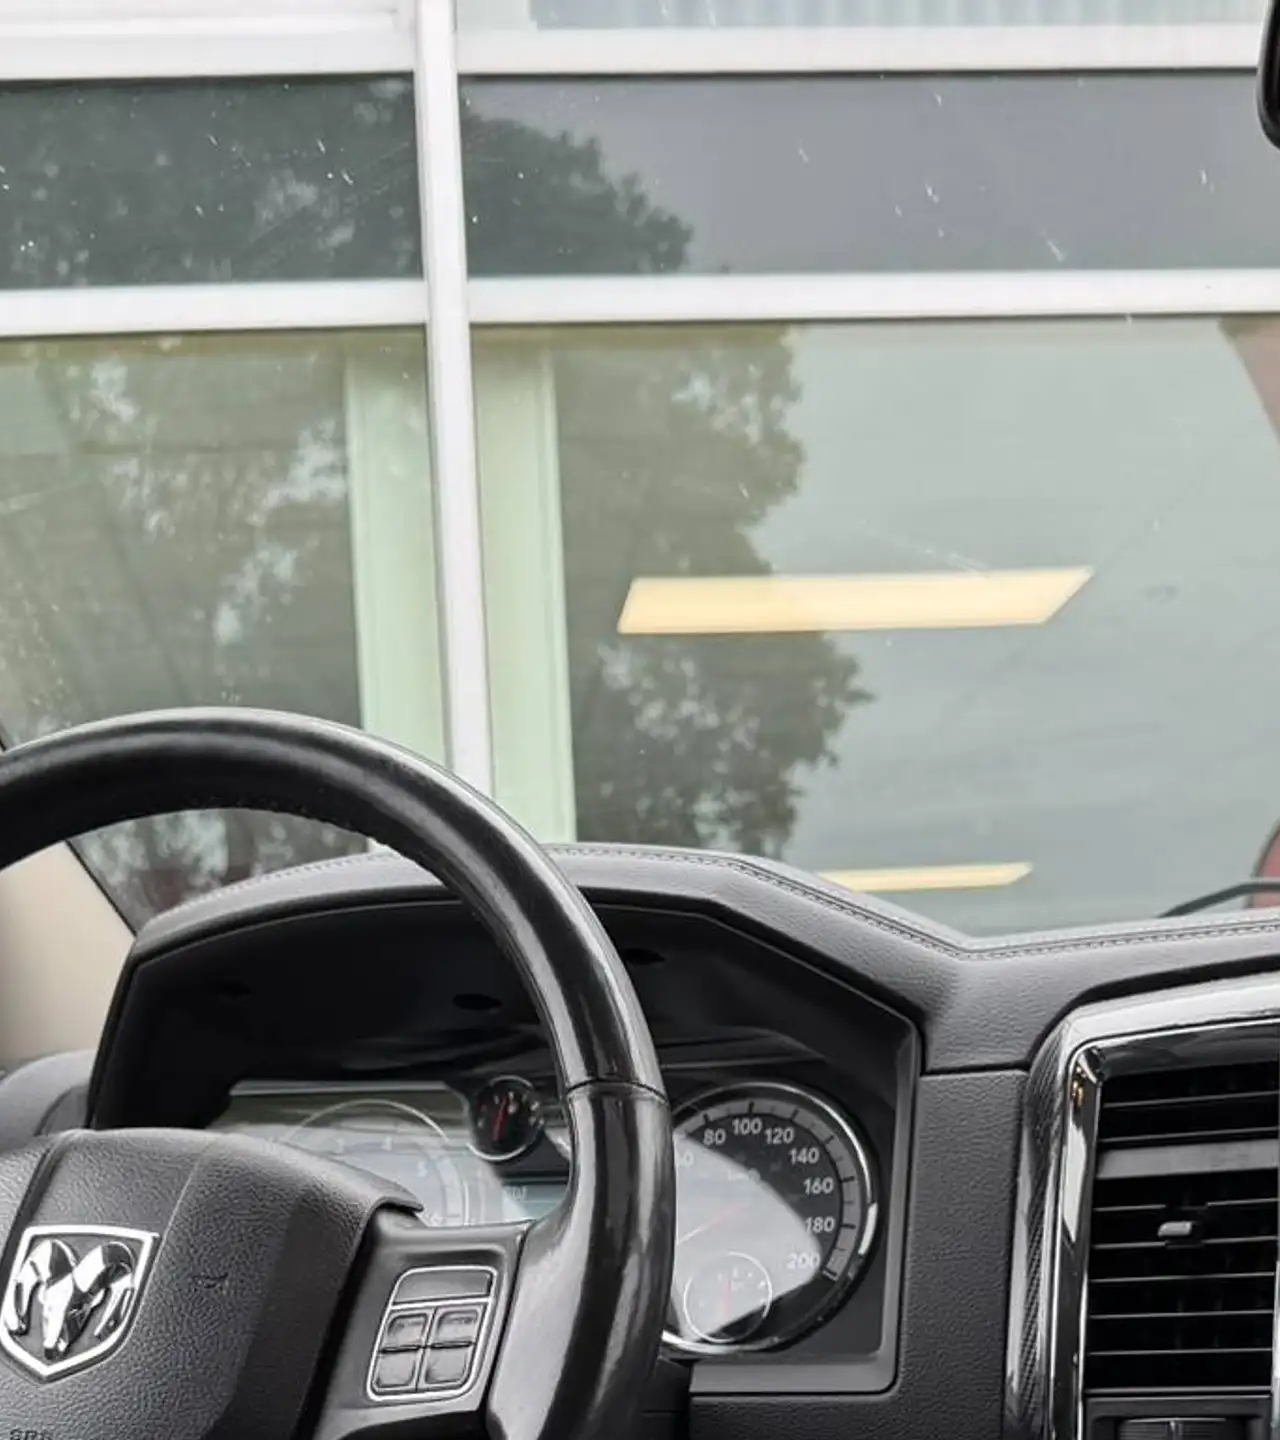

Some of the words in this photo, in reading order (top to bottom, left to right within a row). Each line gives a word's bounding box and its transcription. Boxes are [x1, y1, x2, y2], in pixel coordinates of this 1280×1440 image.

[732, 1118, 762, 1135] 100
[703, 1129, 726, 1145] 80
[765, 1127, 795, 1144] 120
[789, 1147, 819, 1164] 140
[803, 1178, 834, 1195] 160
[805, 1216, 835, 1233] 180
[787, 1253, 820, 1269] 200
